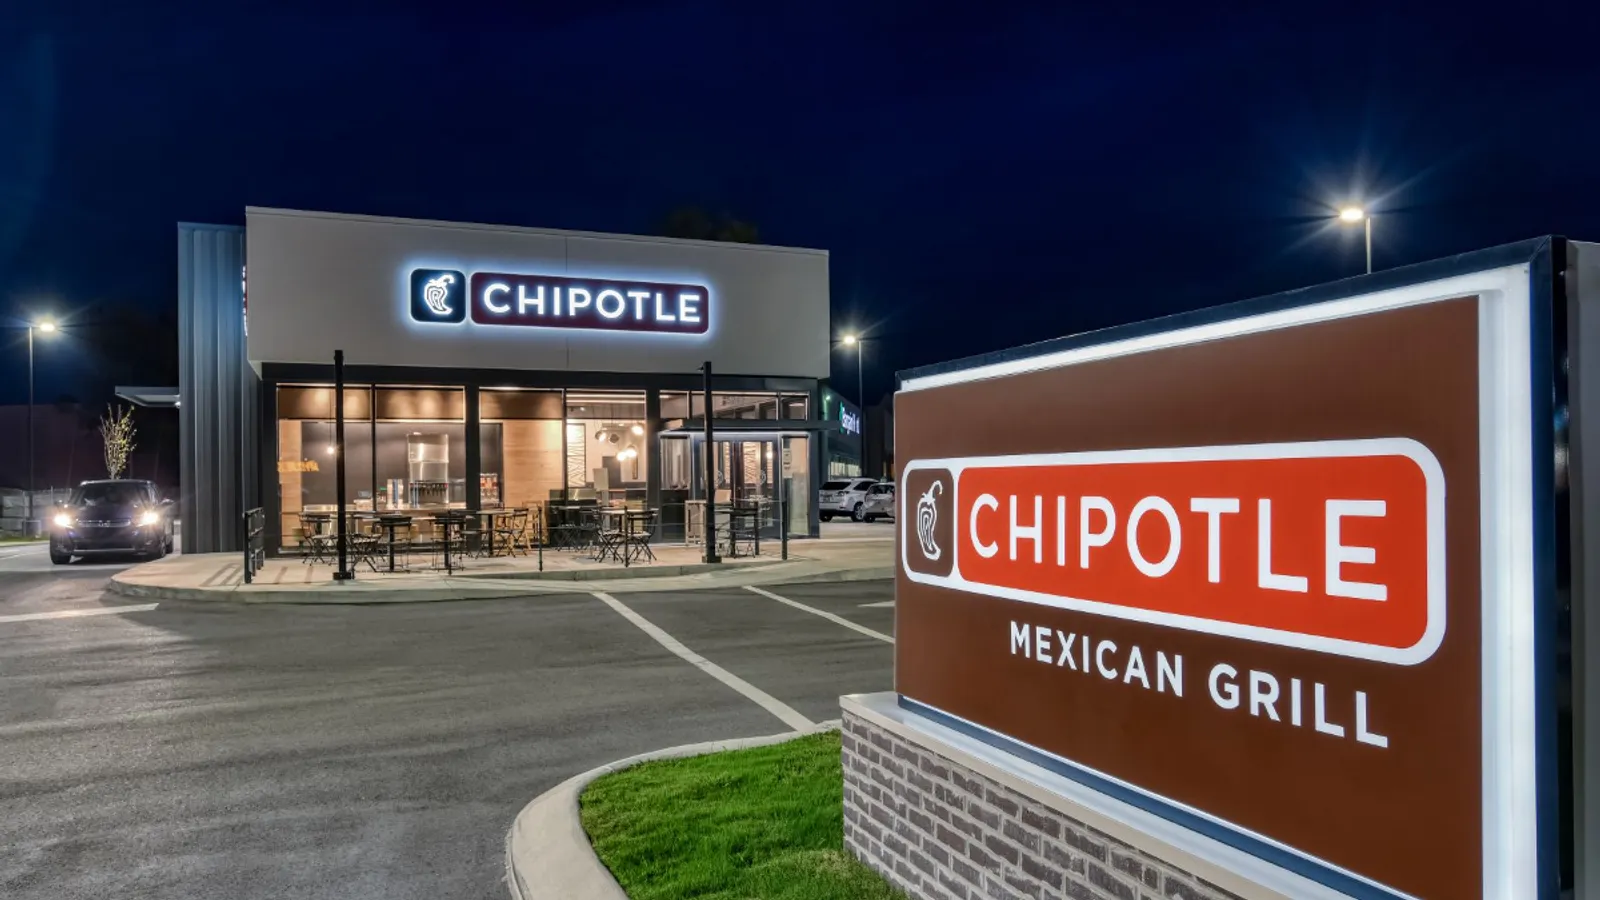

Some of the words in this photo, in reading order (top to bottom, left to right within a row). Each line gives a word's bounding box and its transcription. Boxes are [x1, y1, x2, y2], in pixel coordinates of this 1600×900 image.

[484, 283, 700, 323] CHIPOTLE
[969, 493, 1388, 602] CHIPOTLE
[1010, 621, 1184, 697] MEXICAN
[1208, 664, 1389, 748] GRILL
